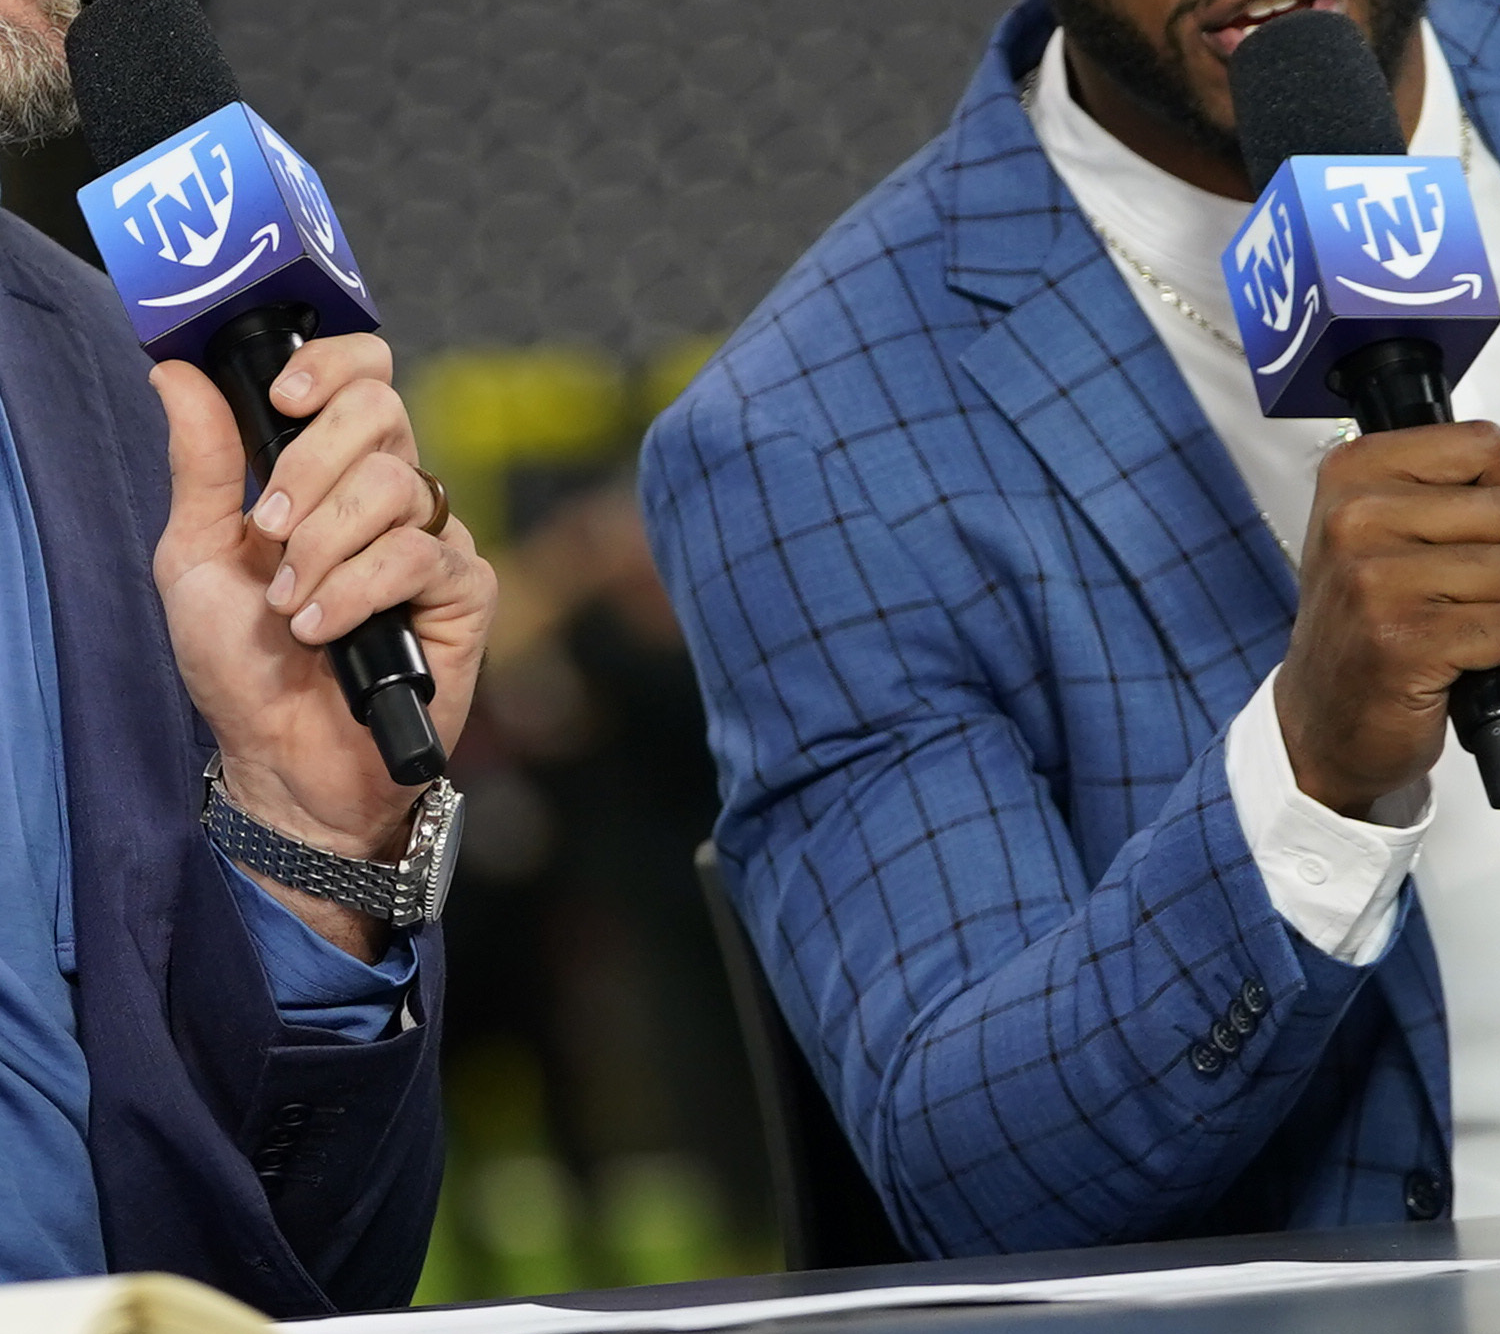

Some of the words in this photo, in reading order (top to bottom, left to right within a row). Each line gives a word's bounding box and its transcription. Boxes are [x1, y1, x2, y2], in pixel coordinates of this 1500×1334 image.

[112, 133, 233, 265] TNF
[1236, 195, 1294, 329] TNF
[1326, 169, 1445, 271] TNF
